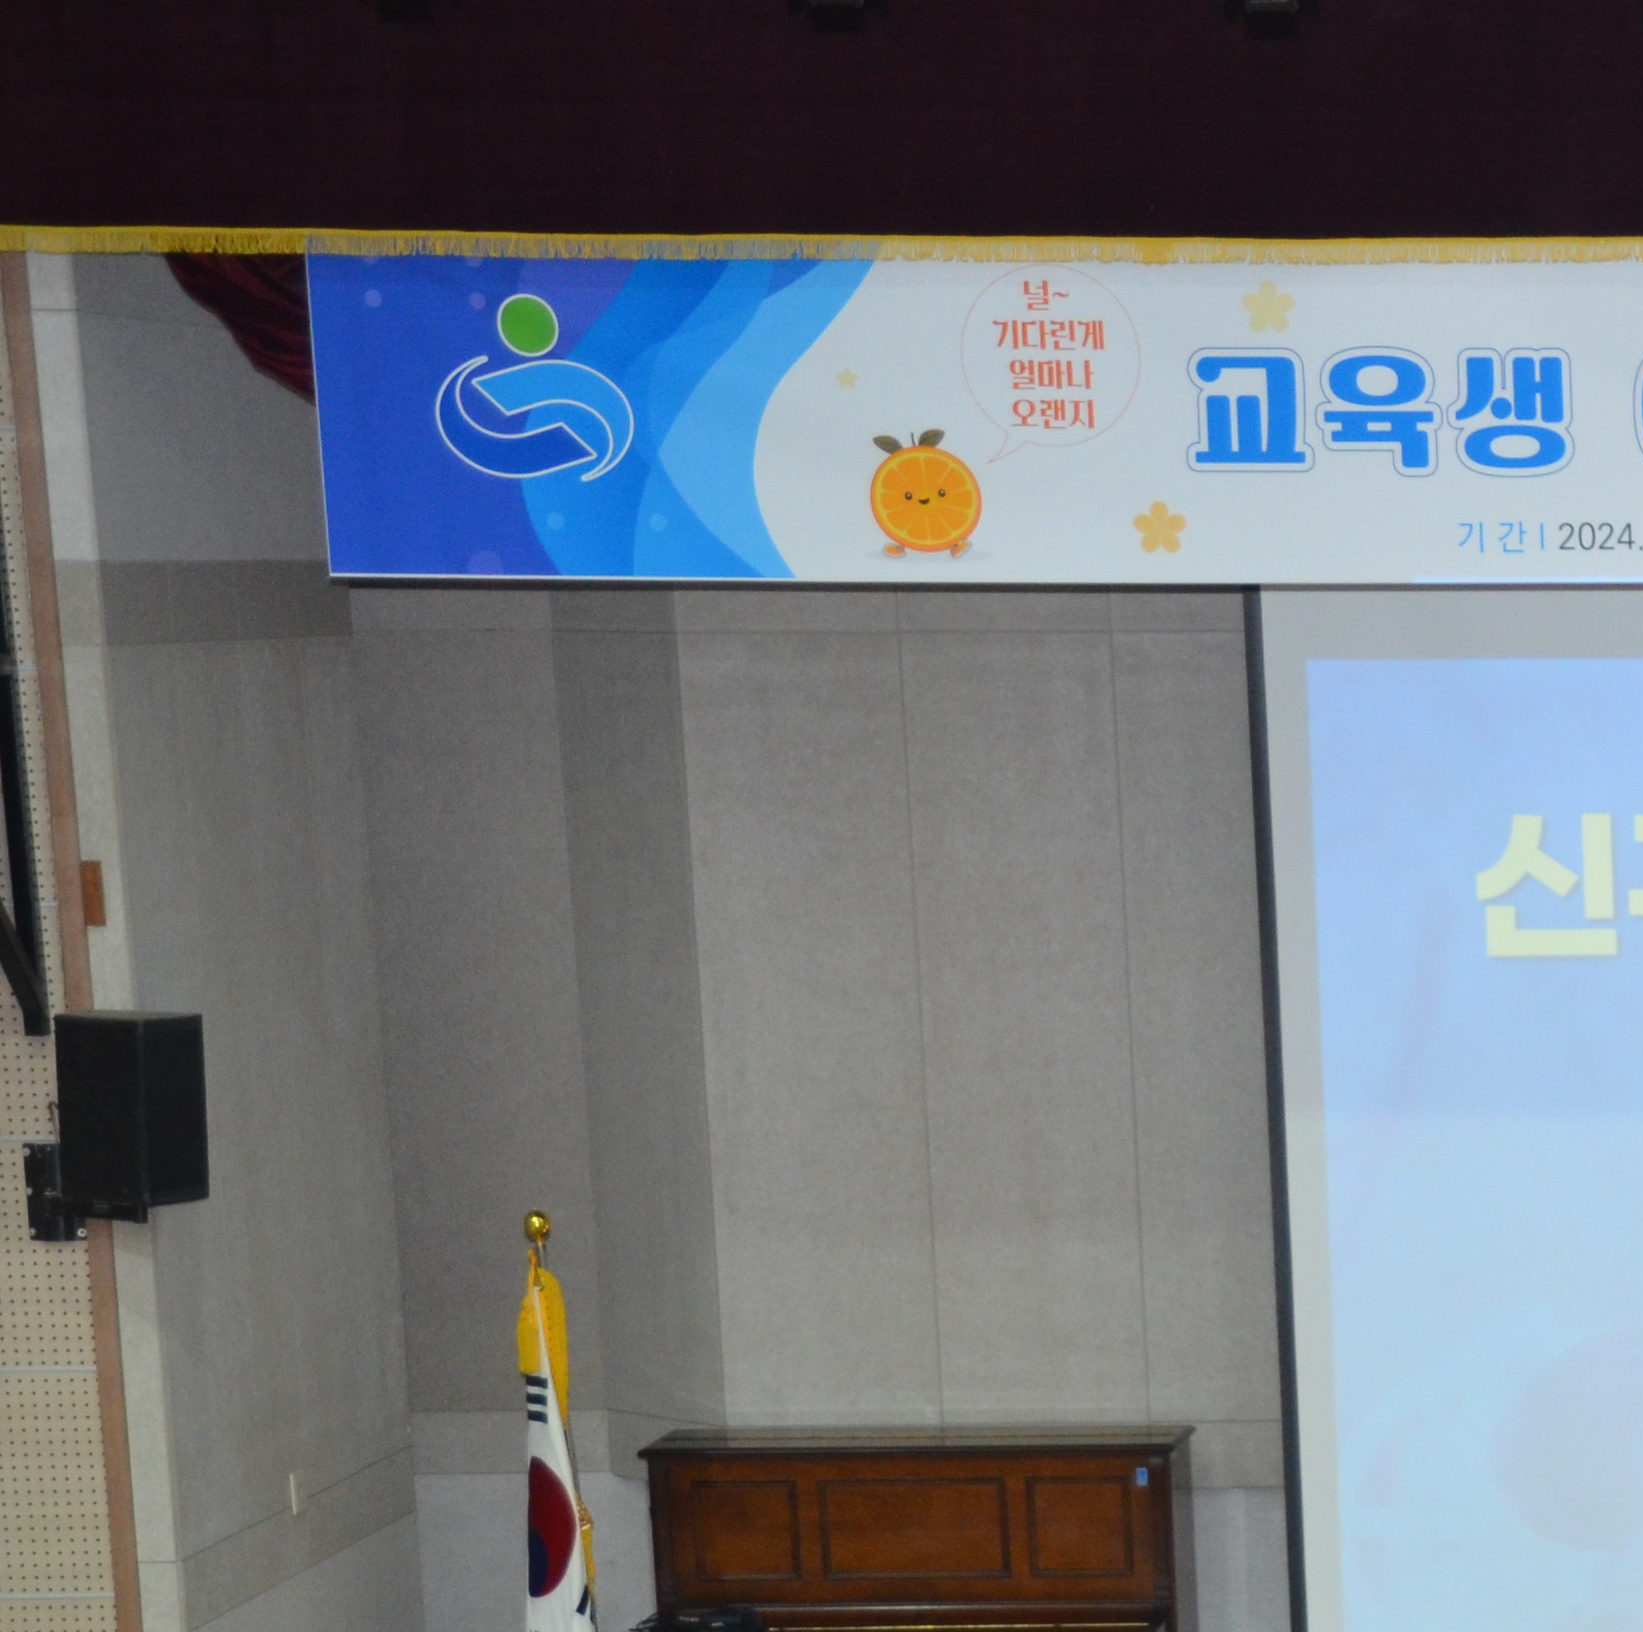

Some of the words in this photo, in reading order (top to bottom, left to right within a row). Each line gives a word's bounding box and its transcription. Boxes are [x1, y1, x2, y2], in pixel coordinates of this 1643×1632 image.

[992, 319, 1105, 350] 기다린게
[1009, 359, 1094, 389] 얼마나
[1194, 353, 1567, 470] 교육생
